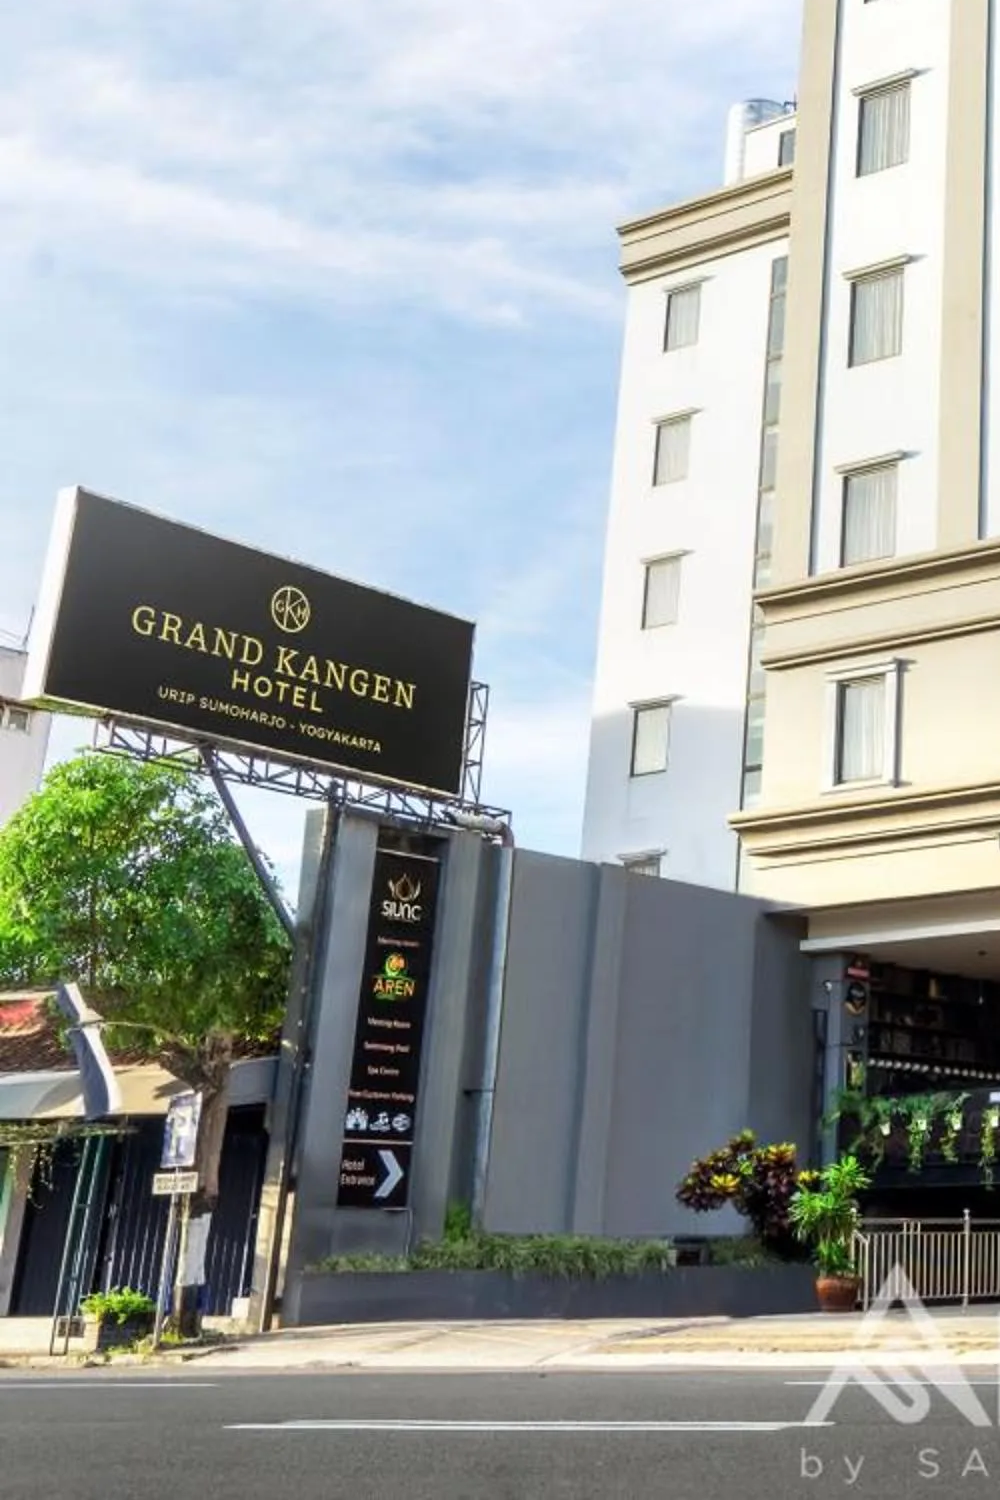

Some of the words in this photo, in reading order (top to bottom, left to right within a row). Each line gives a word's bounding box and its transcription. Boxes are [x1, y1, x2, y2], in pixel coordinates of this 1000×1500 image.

[131, 605, 263, 666] GRAND
[275, 646, 416, 710] KANGEN
[231, 669, 323, 713] HOTEL
[158, 685, 195, 705] URIP
[199, 697, 286, 730] SUMOHARJO
[299, 722, 382, 754] YOGYAKARTA
